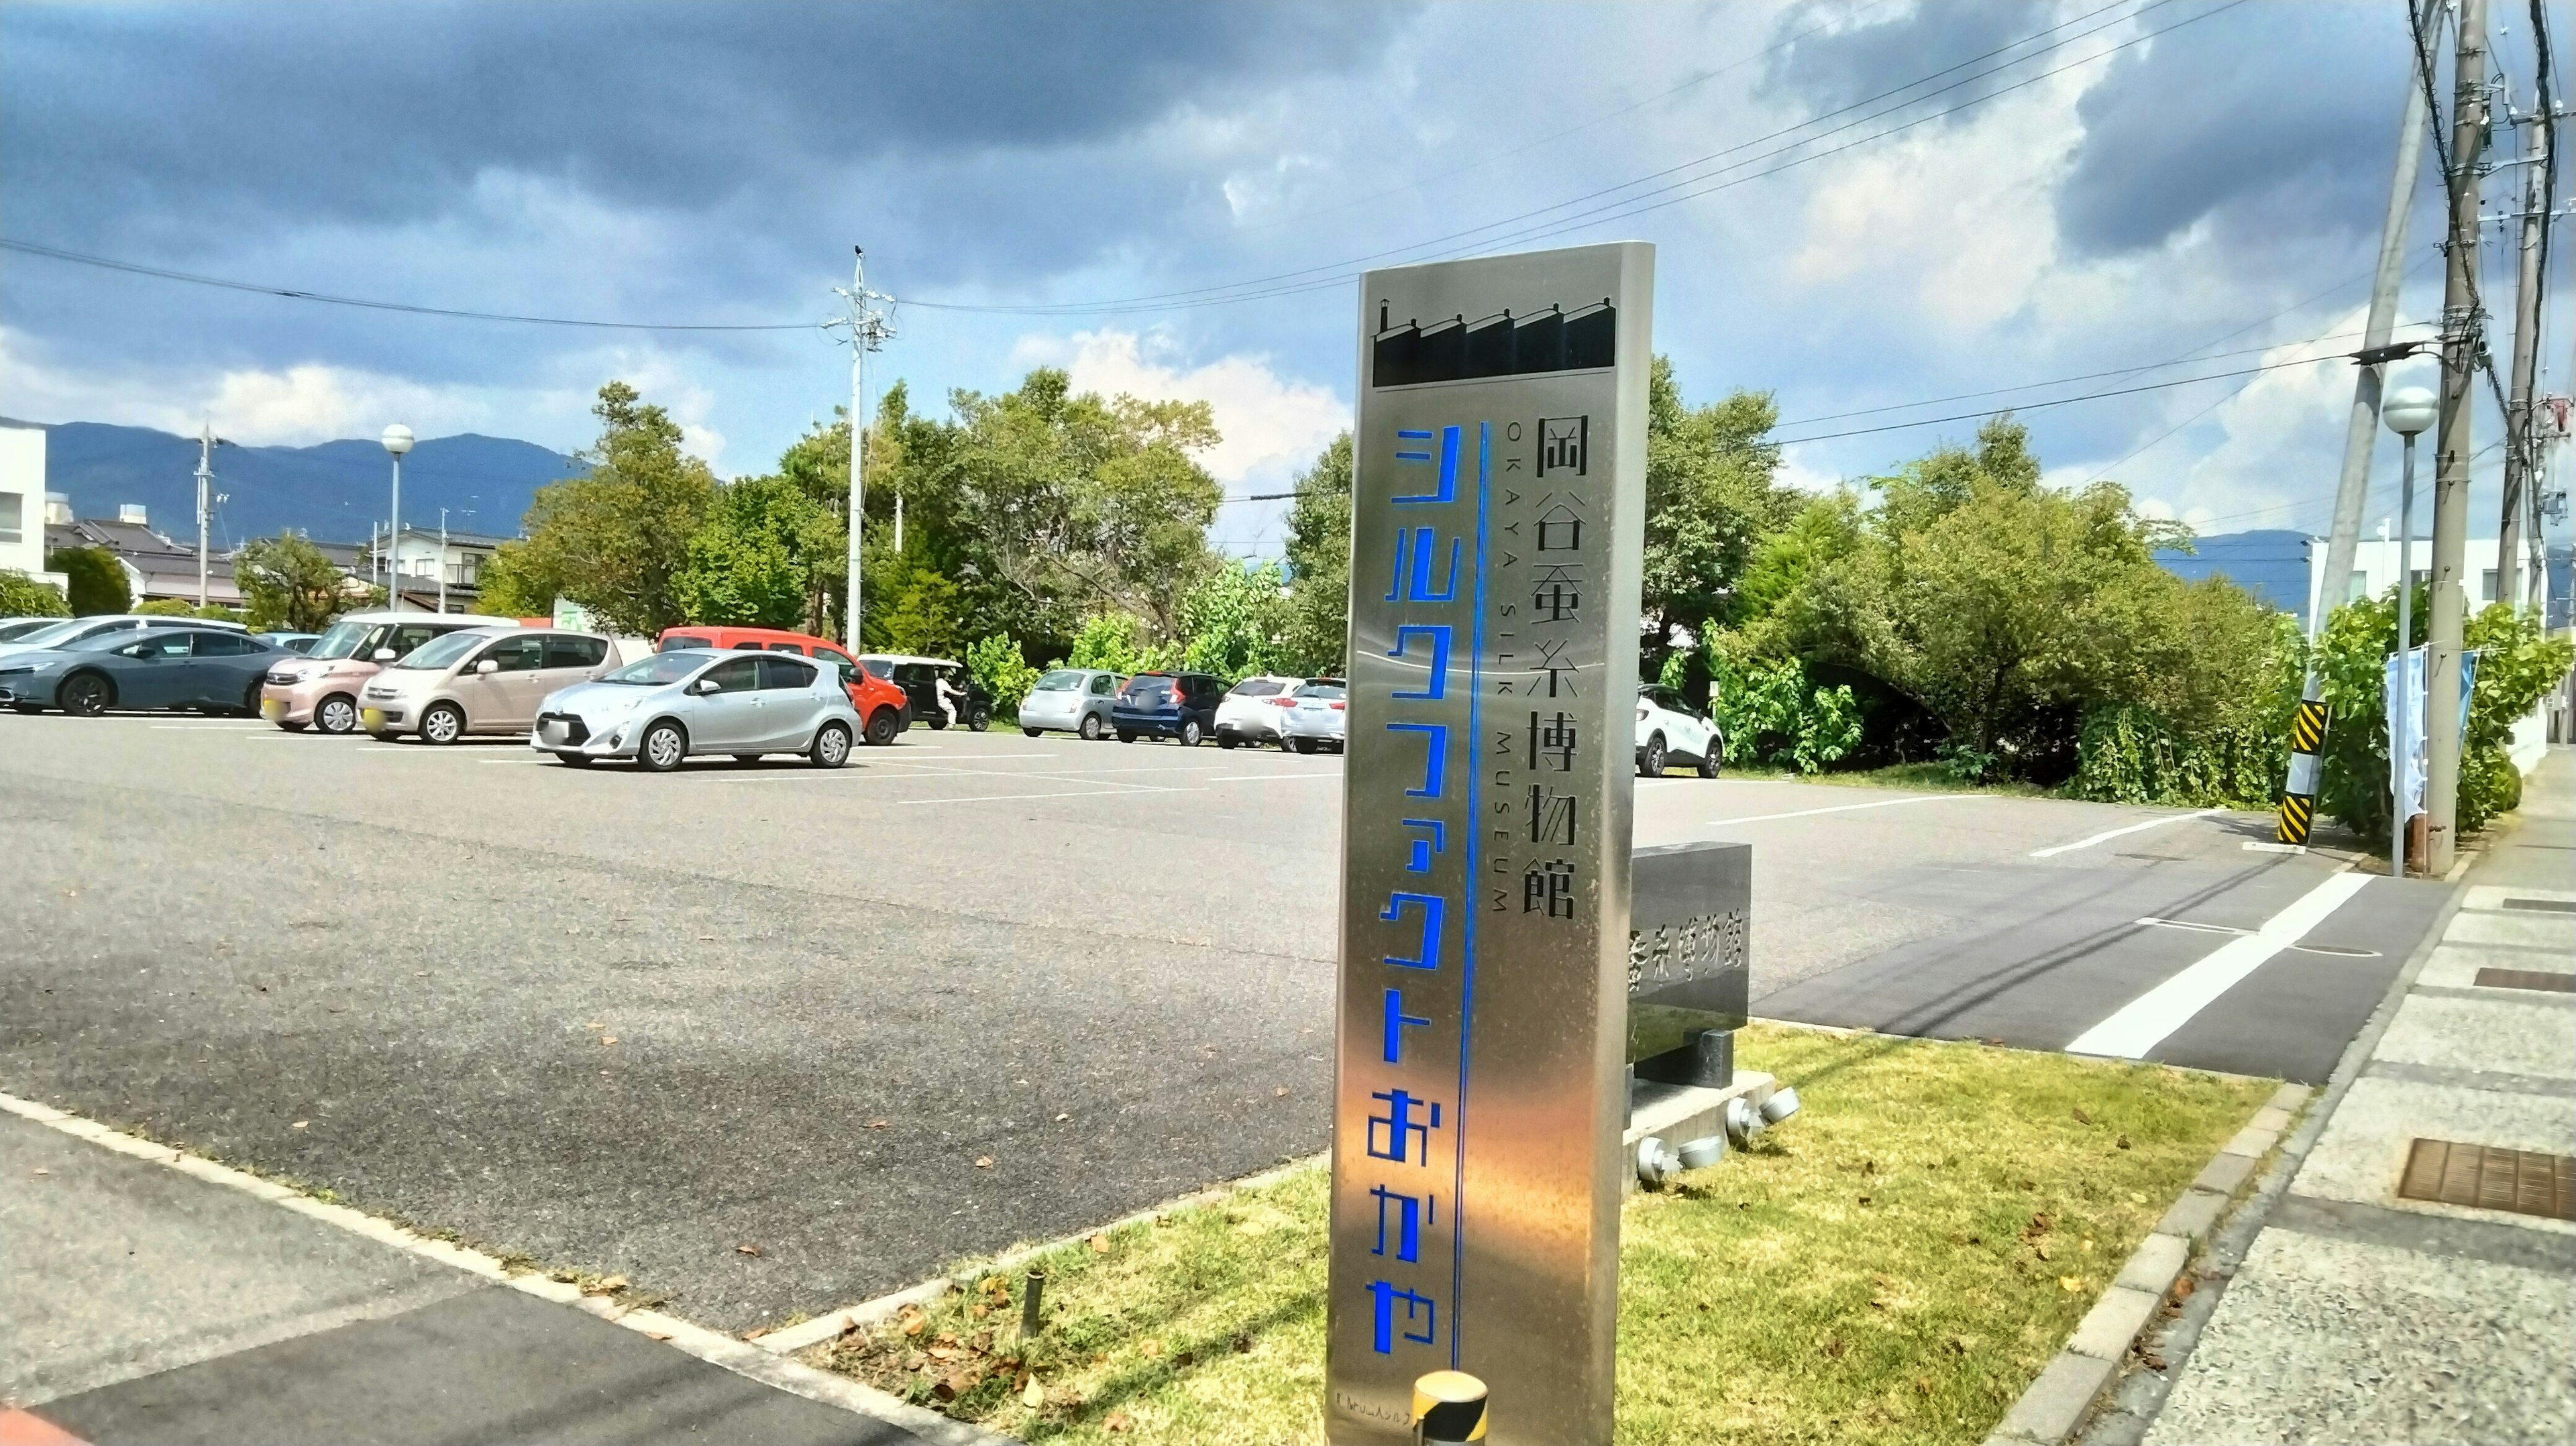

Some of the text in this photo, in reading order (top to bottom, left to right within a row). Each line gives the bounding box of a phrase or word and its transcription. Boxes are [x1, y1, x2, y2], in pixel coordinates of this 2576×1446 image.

[1493, 421, 1522, 912] OKAYA SILK MUSEUM
[1523, 414, 1589, 920] 岡谷蚕糸博物館
